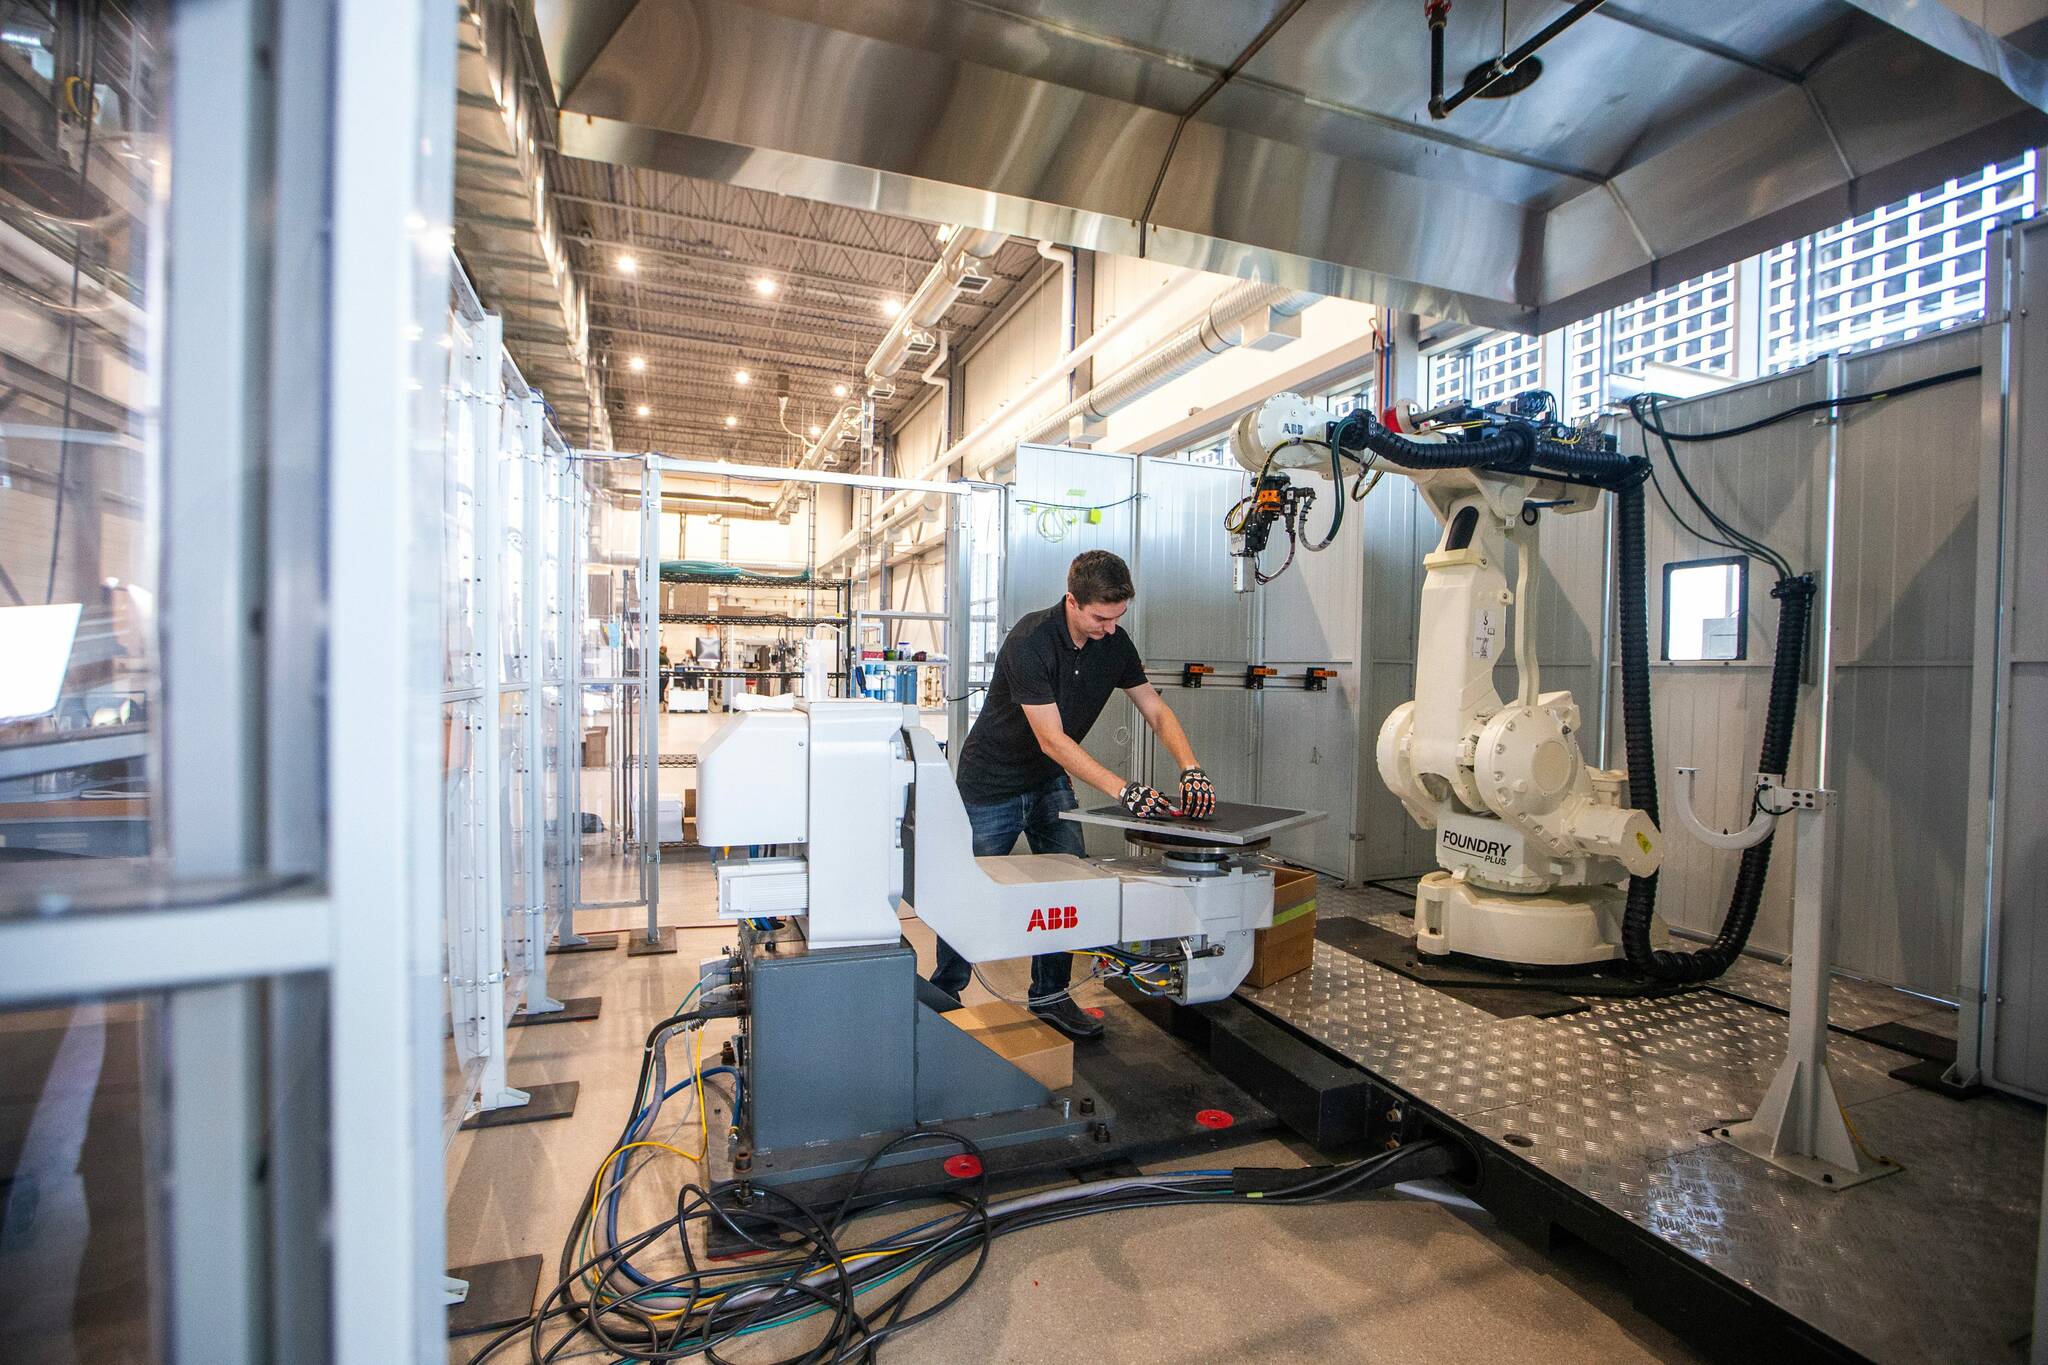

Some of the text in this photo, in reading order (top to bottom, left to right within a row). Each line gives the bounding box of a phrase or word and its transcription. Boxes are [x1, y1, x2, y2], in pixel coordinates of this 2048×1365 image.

[1282, 423, 1304, 435] ABB
[1443, 830, 1512, 858] FOUNDRY
[1484, 855, 1507, 866] PLUS
[1026, 906, 1079, 932] ABB
